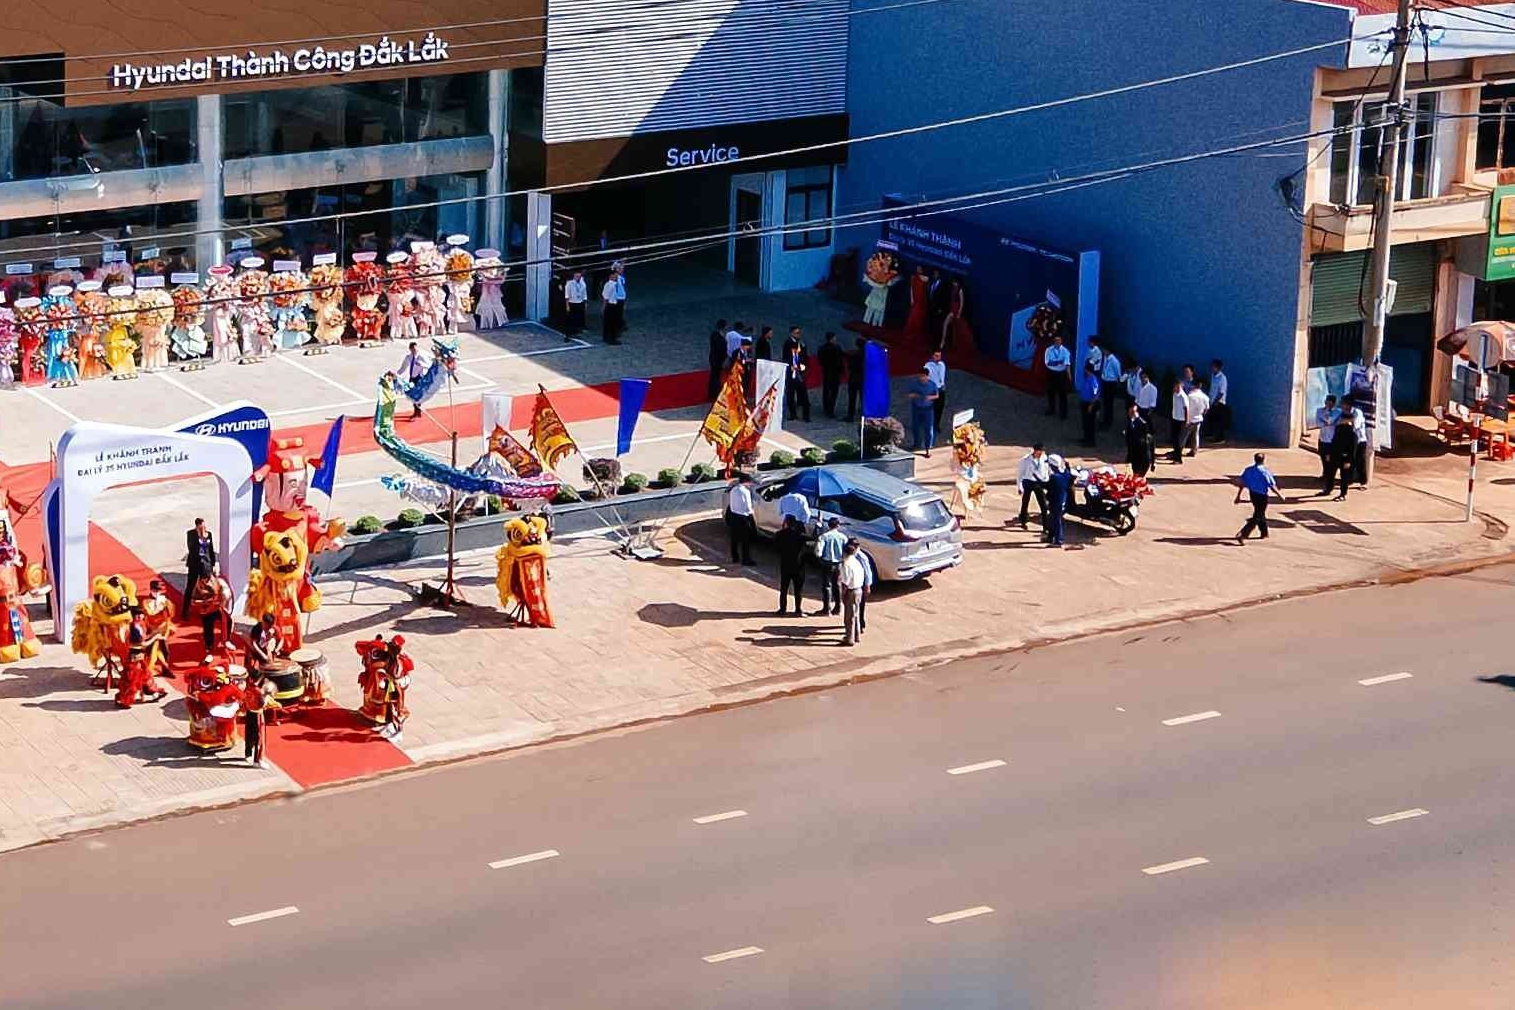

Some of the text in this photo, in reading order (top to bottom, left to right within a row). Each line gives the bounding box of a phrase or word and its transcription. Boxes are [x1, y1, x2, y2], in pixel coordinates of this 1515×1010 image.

[113, 31, 449, 90] Hyundai Thành Công Đắk Lắk
[666, 143, 740, 166] Service
[217, 418, 269, 434] HYUNDAI
